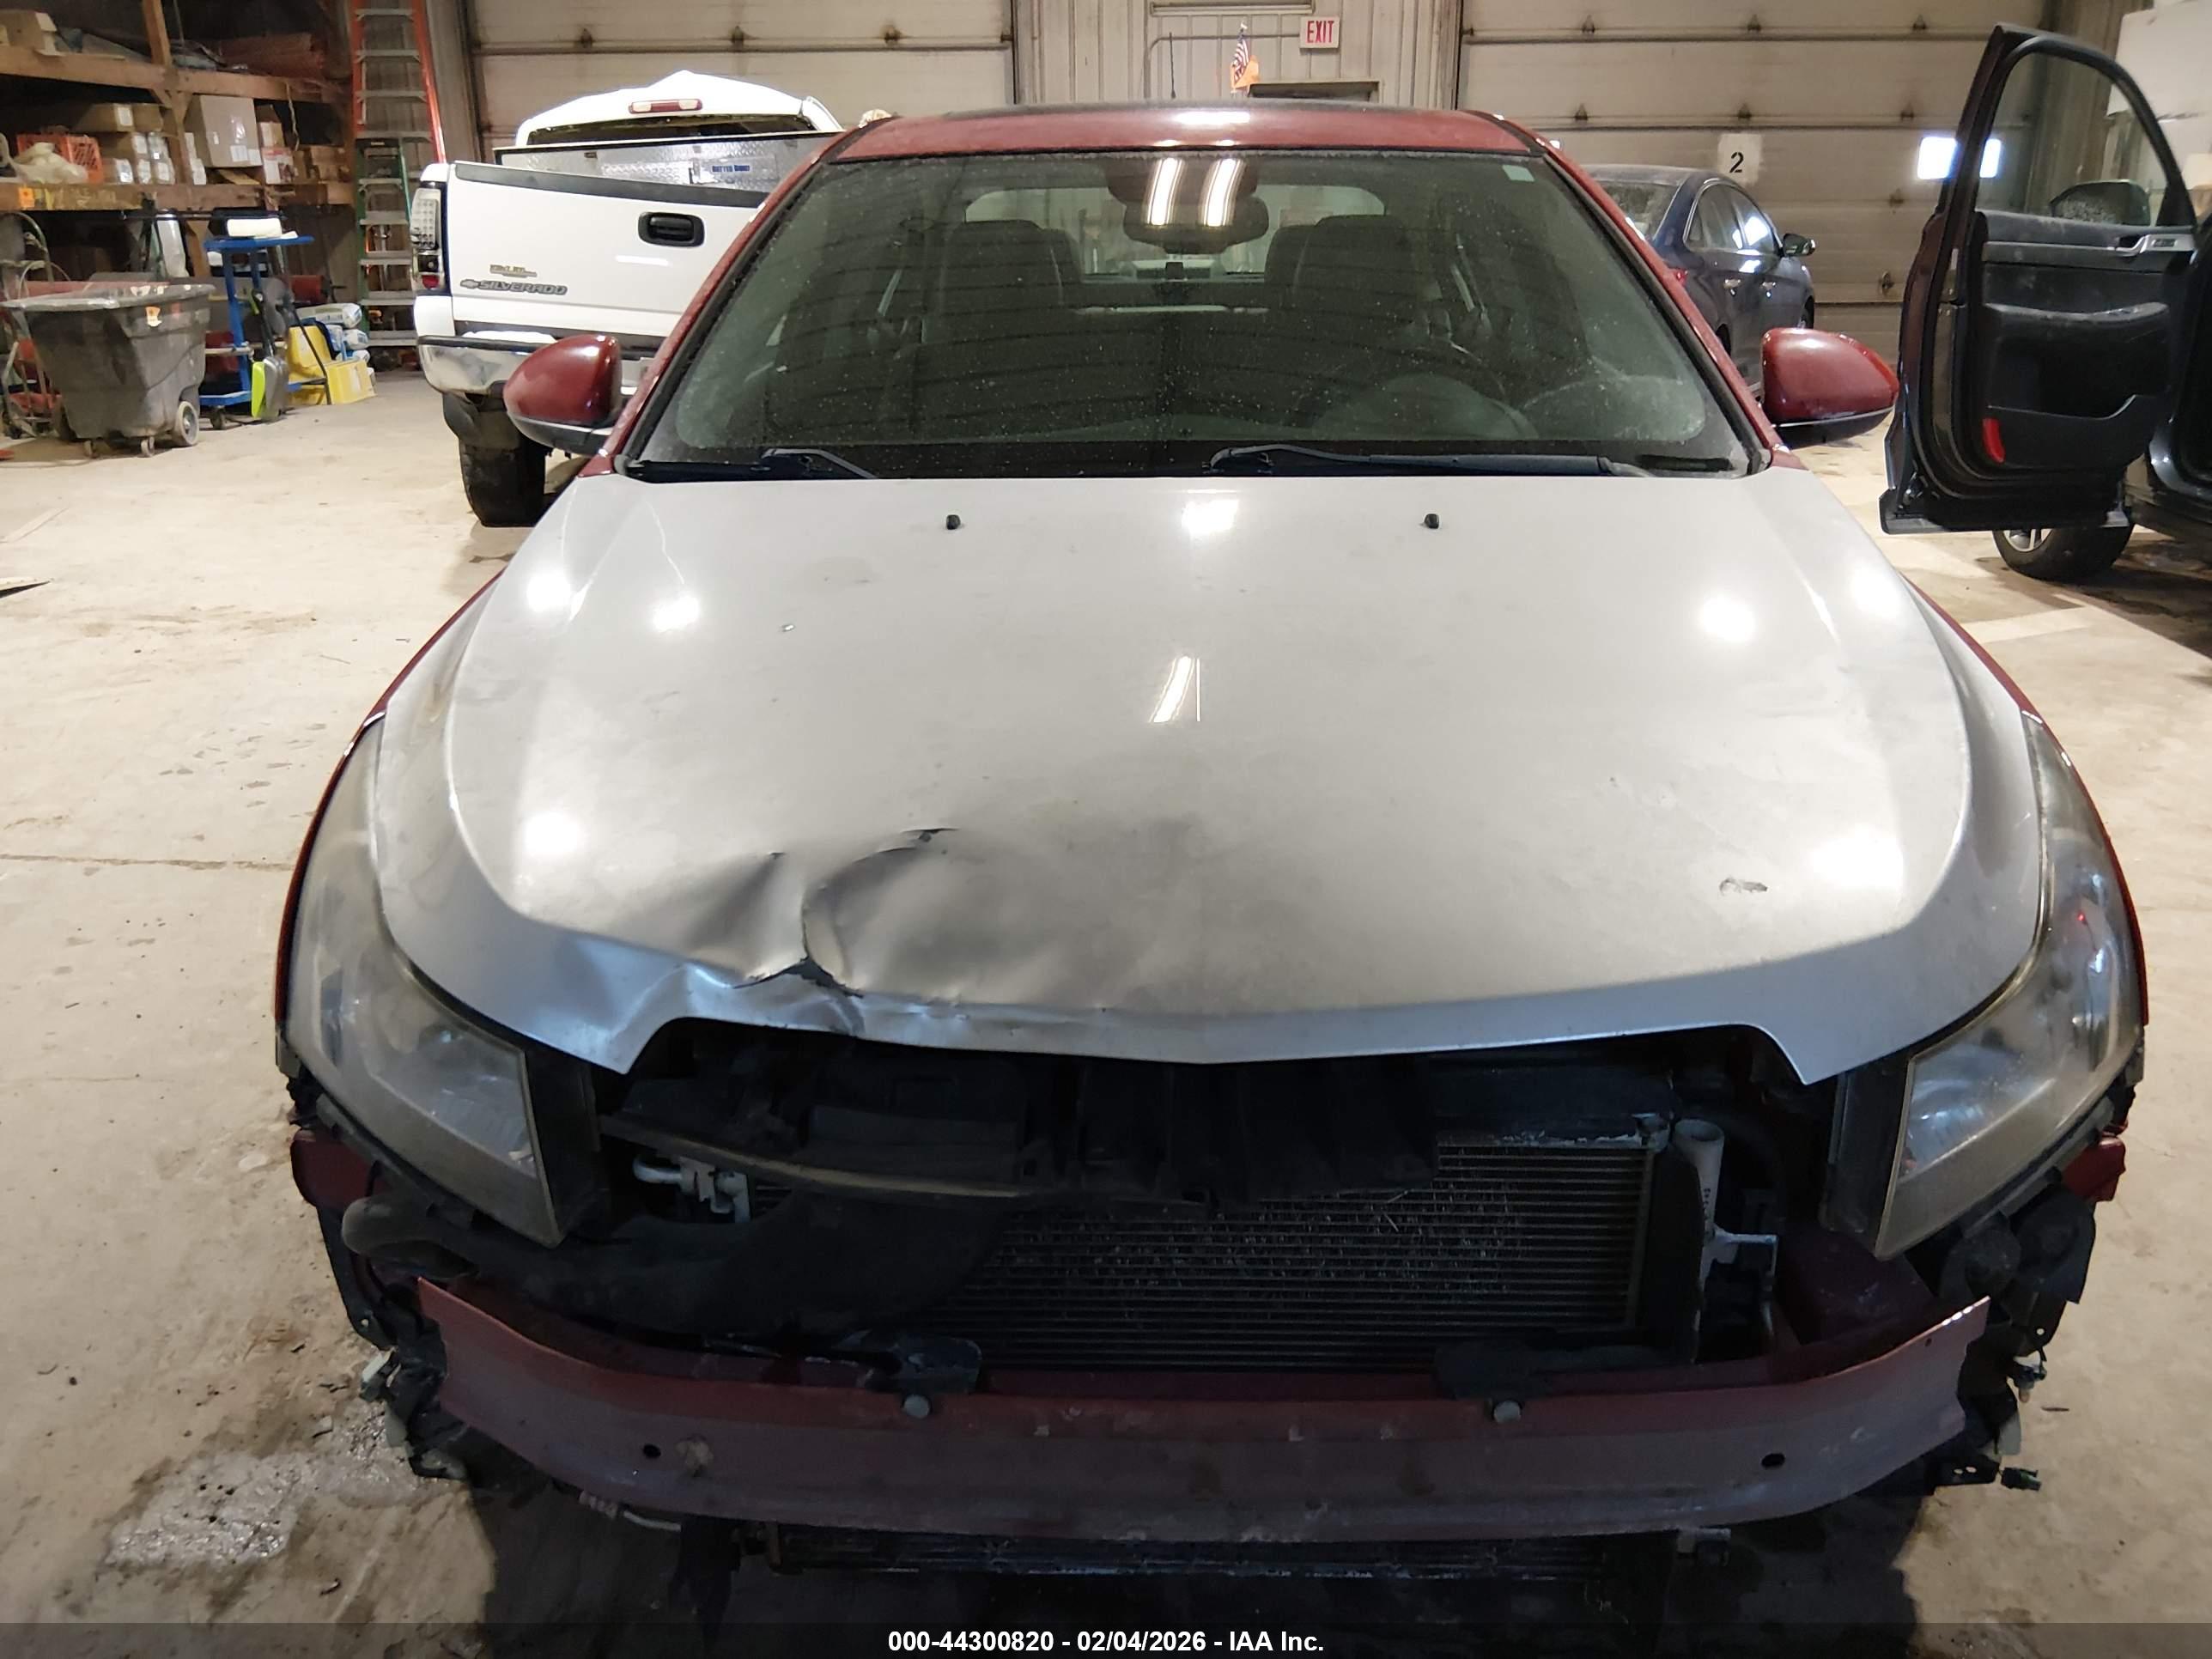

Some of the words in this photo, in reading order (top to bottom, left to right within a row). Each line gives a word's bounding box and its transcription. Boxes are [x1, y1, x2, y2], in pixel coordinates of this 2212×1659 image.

[1307, 20, 1334, 43] EXIT
[1729, 151, 1744, 173] 2
[478, 280, 568, 295] SILVERADO
